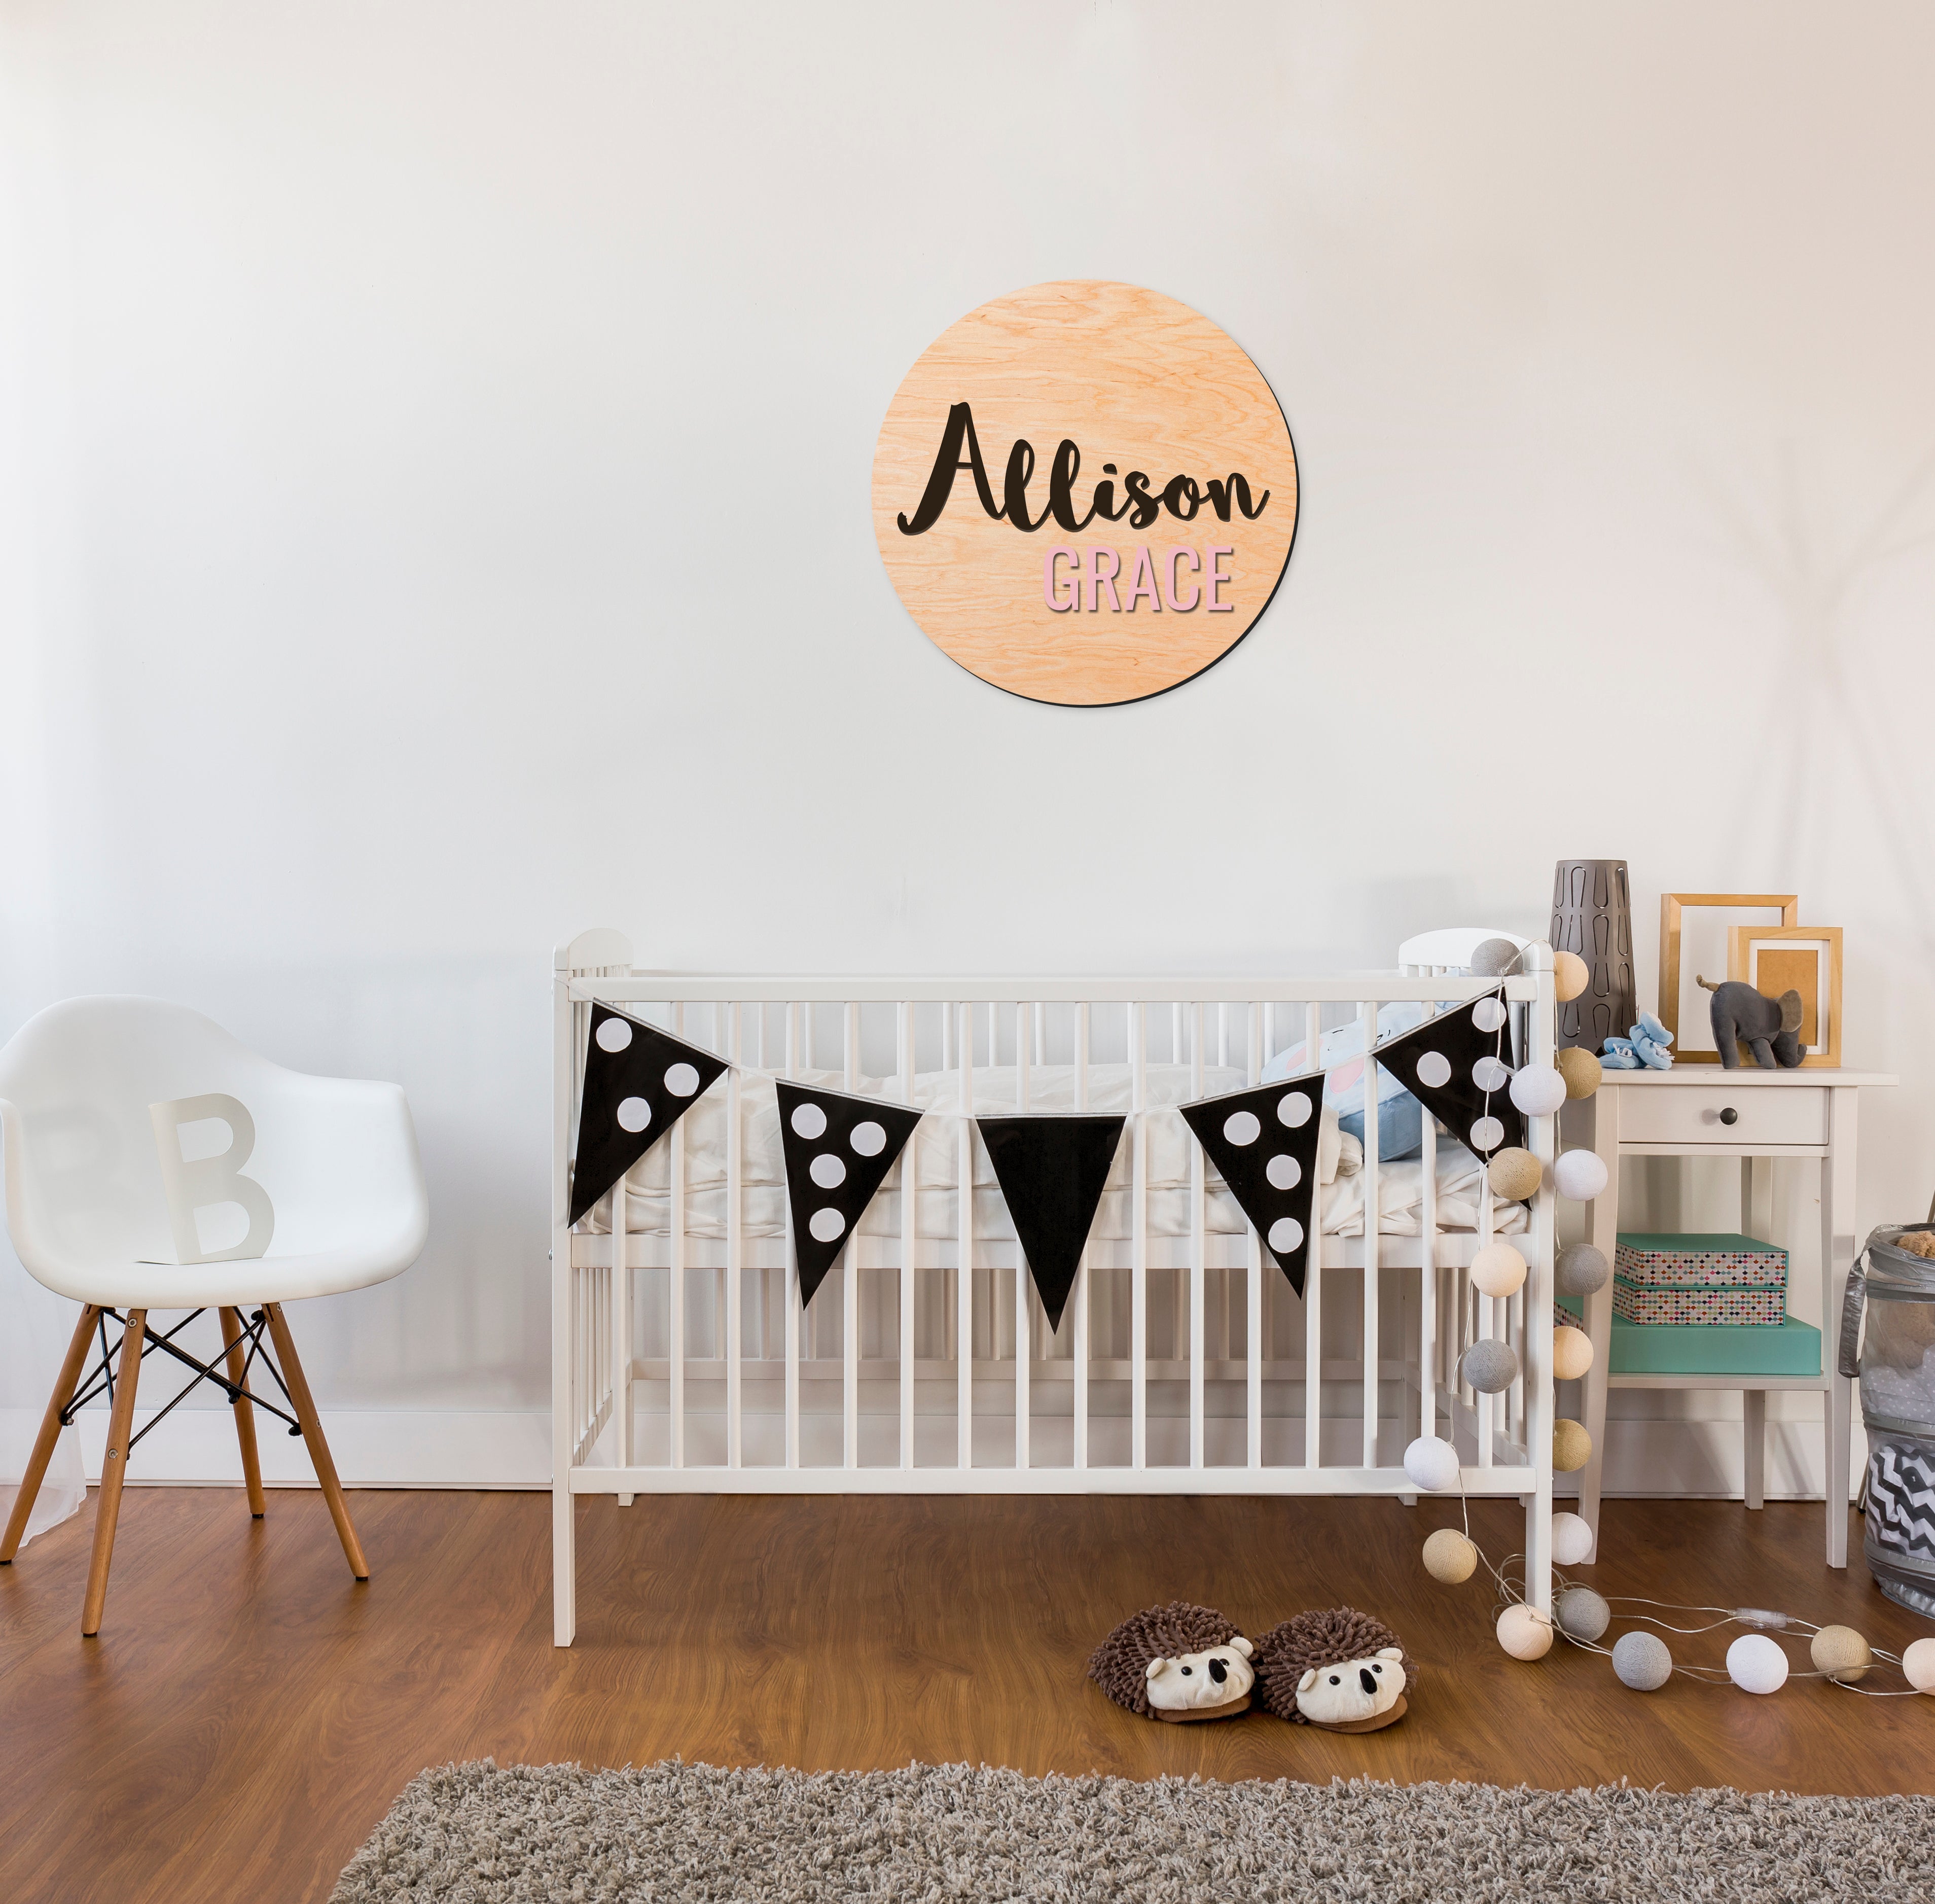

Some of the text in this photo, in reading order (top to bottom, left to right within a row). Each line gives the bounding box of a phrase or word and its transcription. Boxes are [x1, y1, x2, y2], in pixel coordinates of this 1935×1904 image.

[897, 402, 1270, 535] Allison
[1043, 545, 1233, 612] GRACE
[148, 1092, 275, 1265] B
